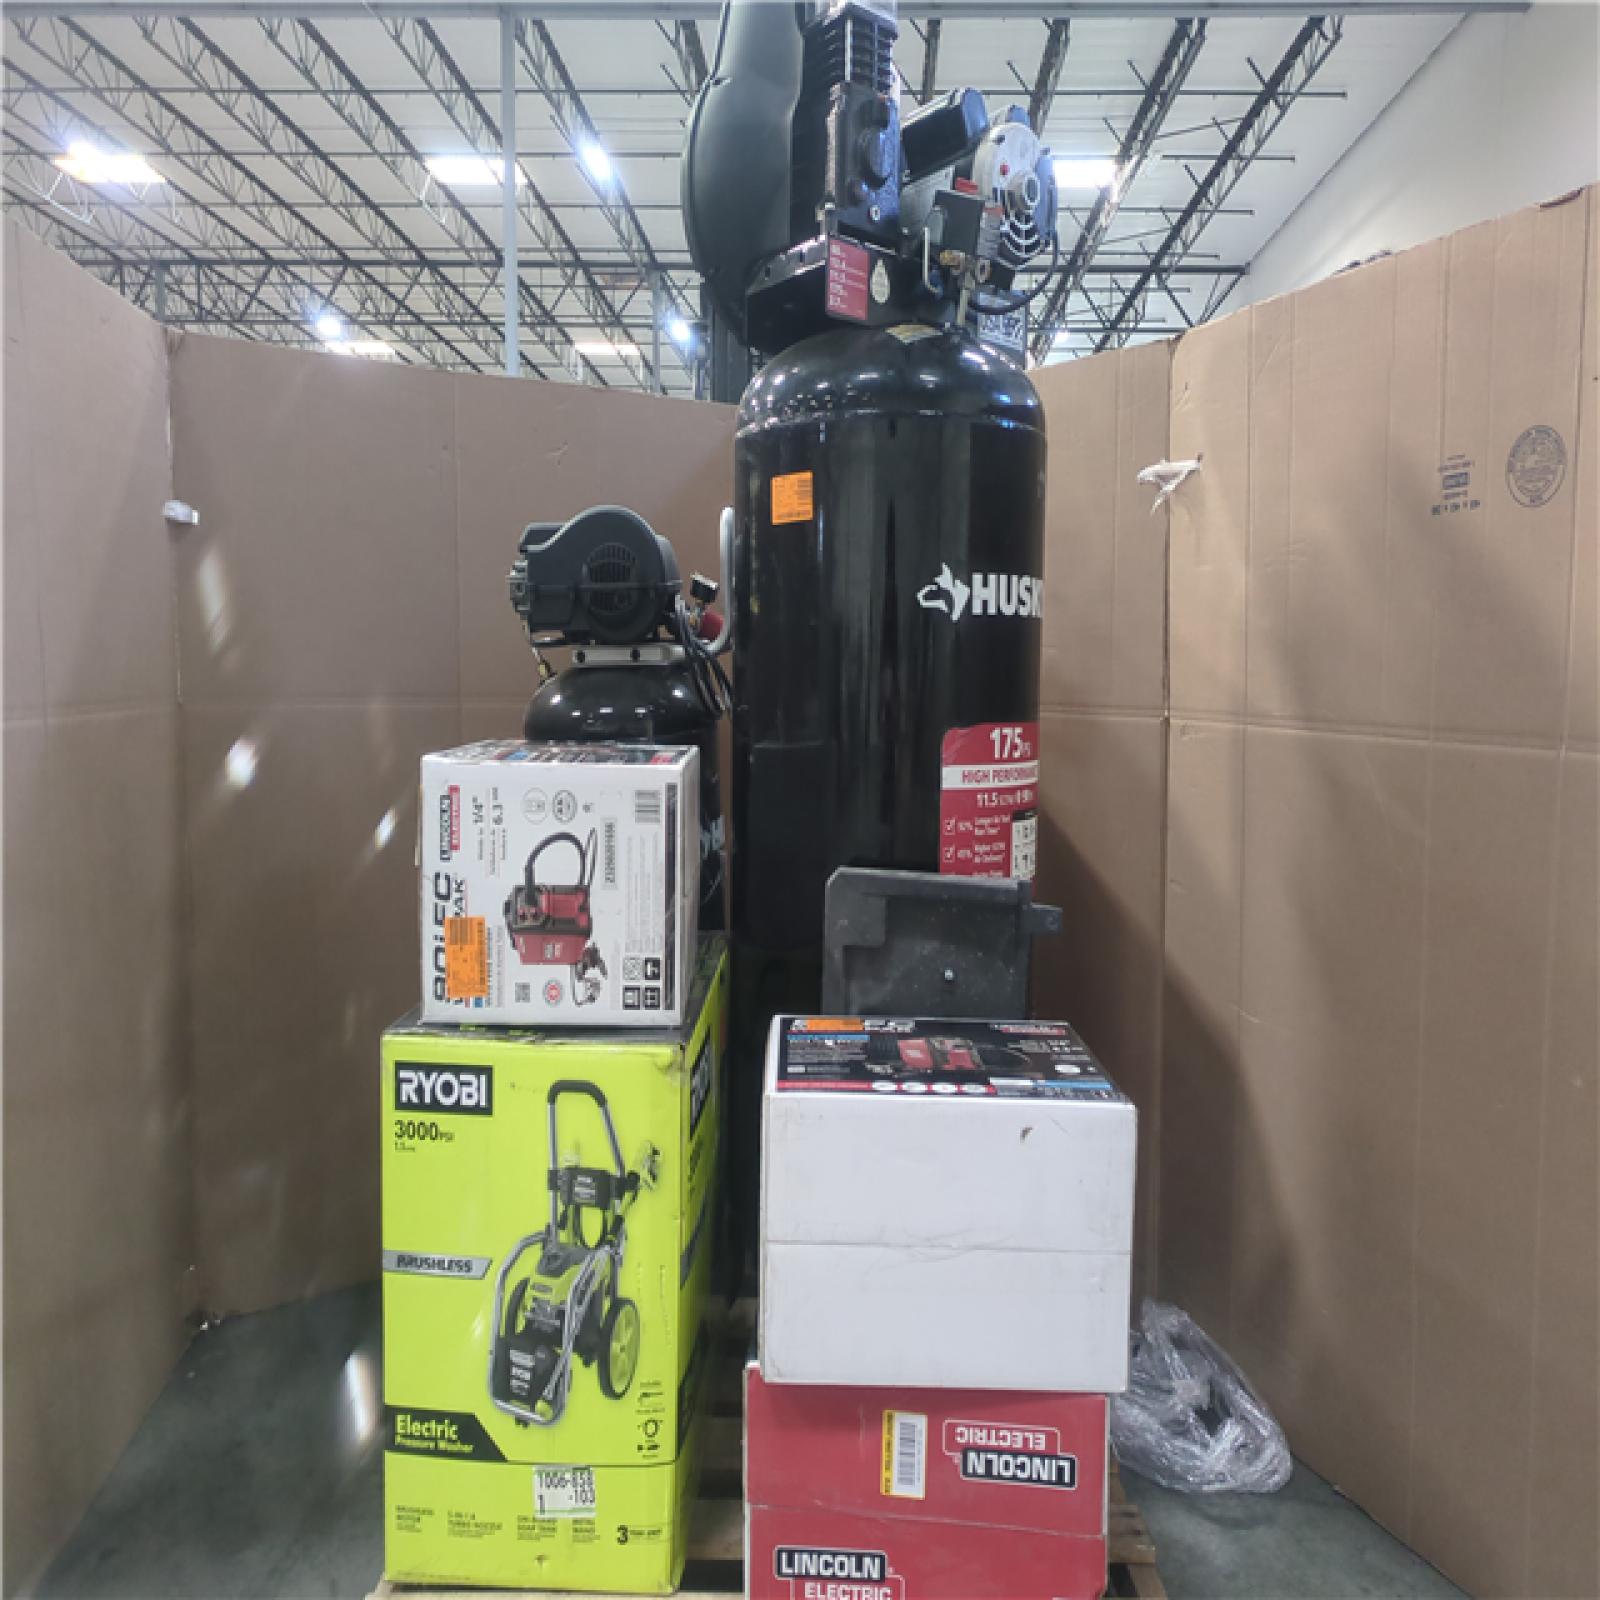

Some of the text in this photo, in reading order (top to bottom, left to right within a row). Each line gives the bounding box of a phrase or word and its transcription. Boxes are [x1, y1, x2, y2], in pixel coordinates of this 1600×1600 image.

[990, 727, 1023, 760] 175
[963, 769, 990, 784] HIGH
[399, 1070, 487, 1108] RYOBI
[396, 1254, 474, 1273] BRUSHLESS
[395, 1414, 458, 1441] Electric
[955, 1426, 1046, 1451] ELECTRIC
[965, 1451, 1071, 1484] LINCOLN
[617, 1524, 628, 1545] 3
[781, 1552, 881, 1580] LINCOLN
[804, 1582, 893, 1600] ELECTRIC
